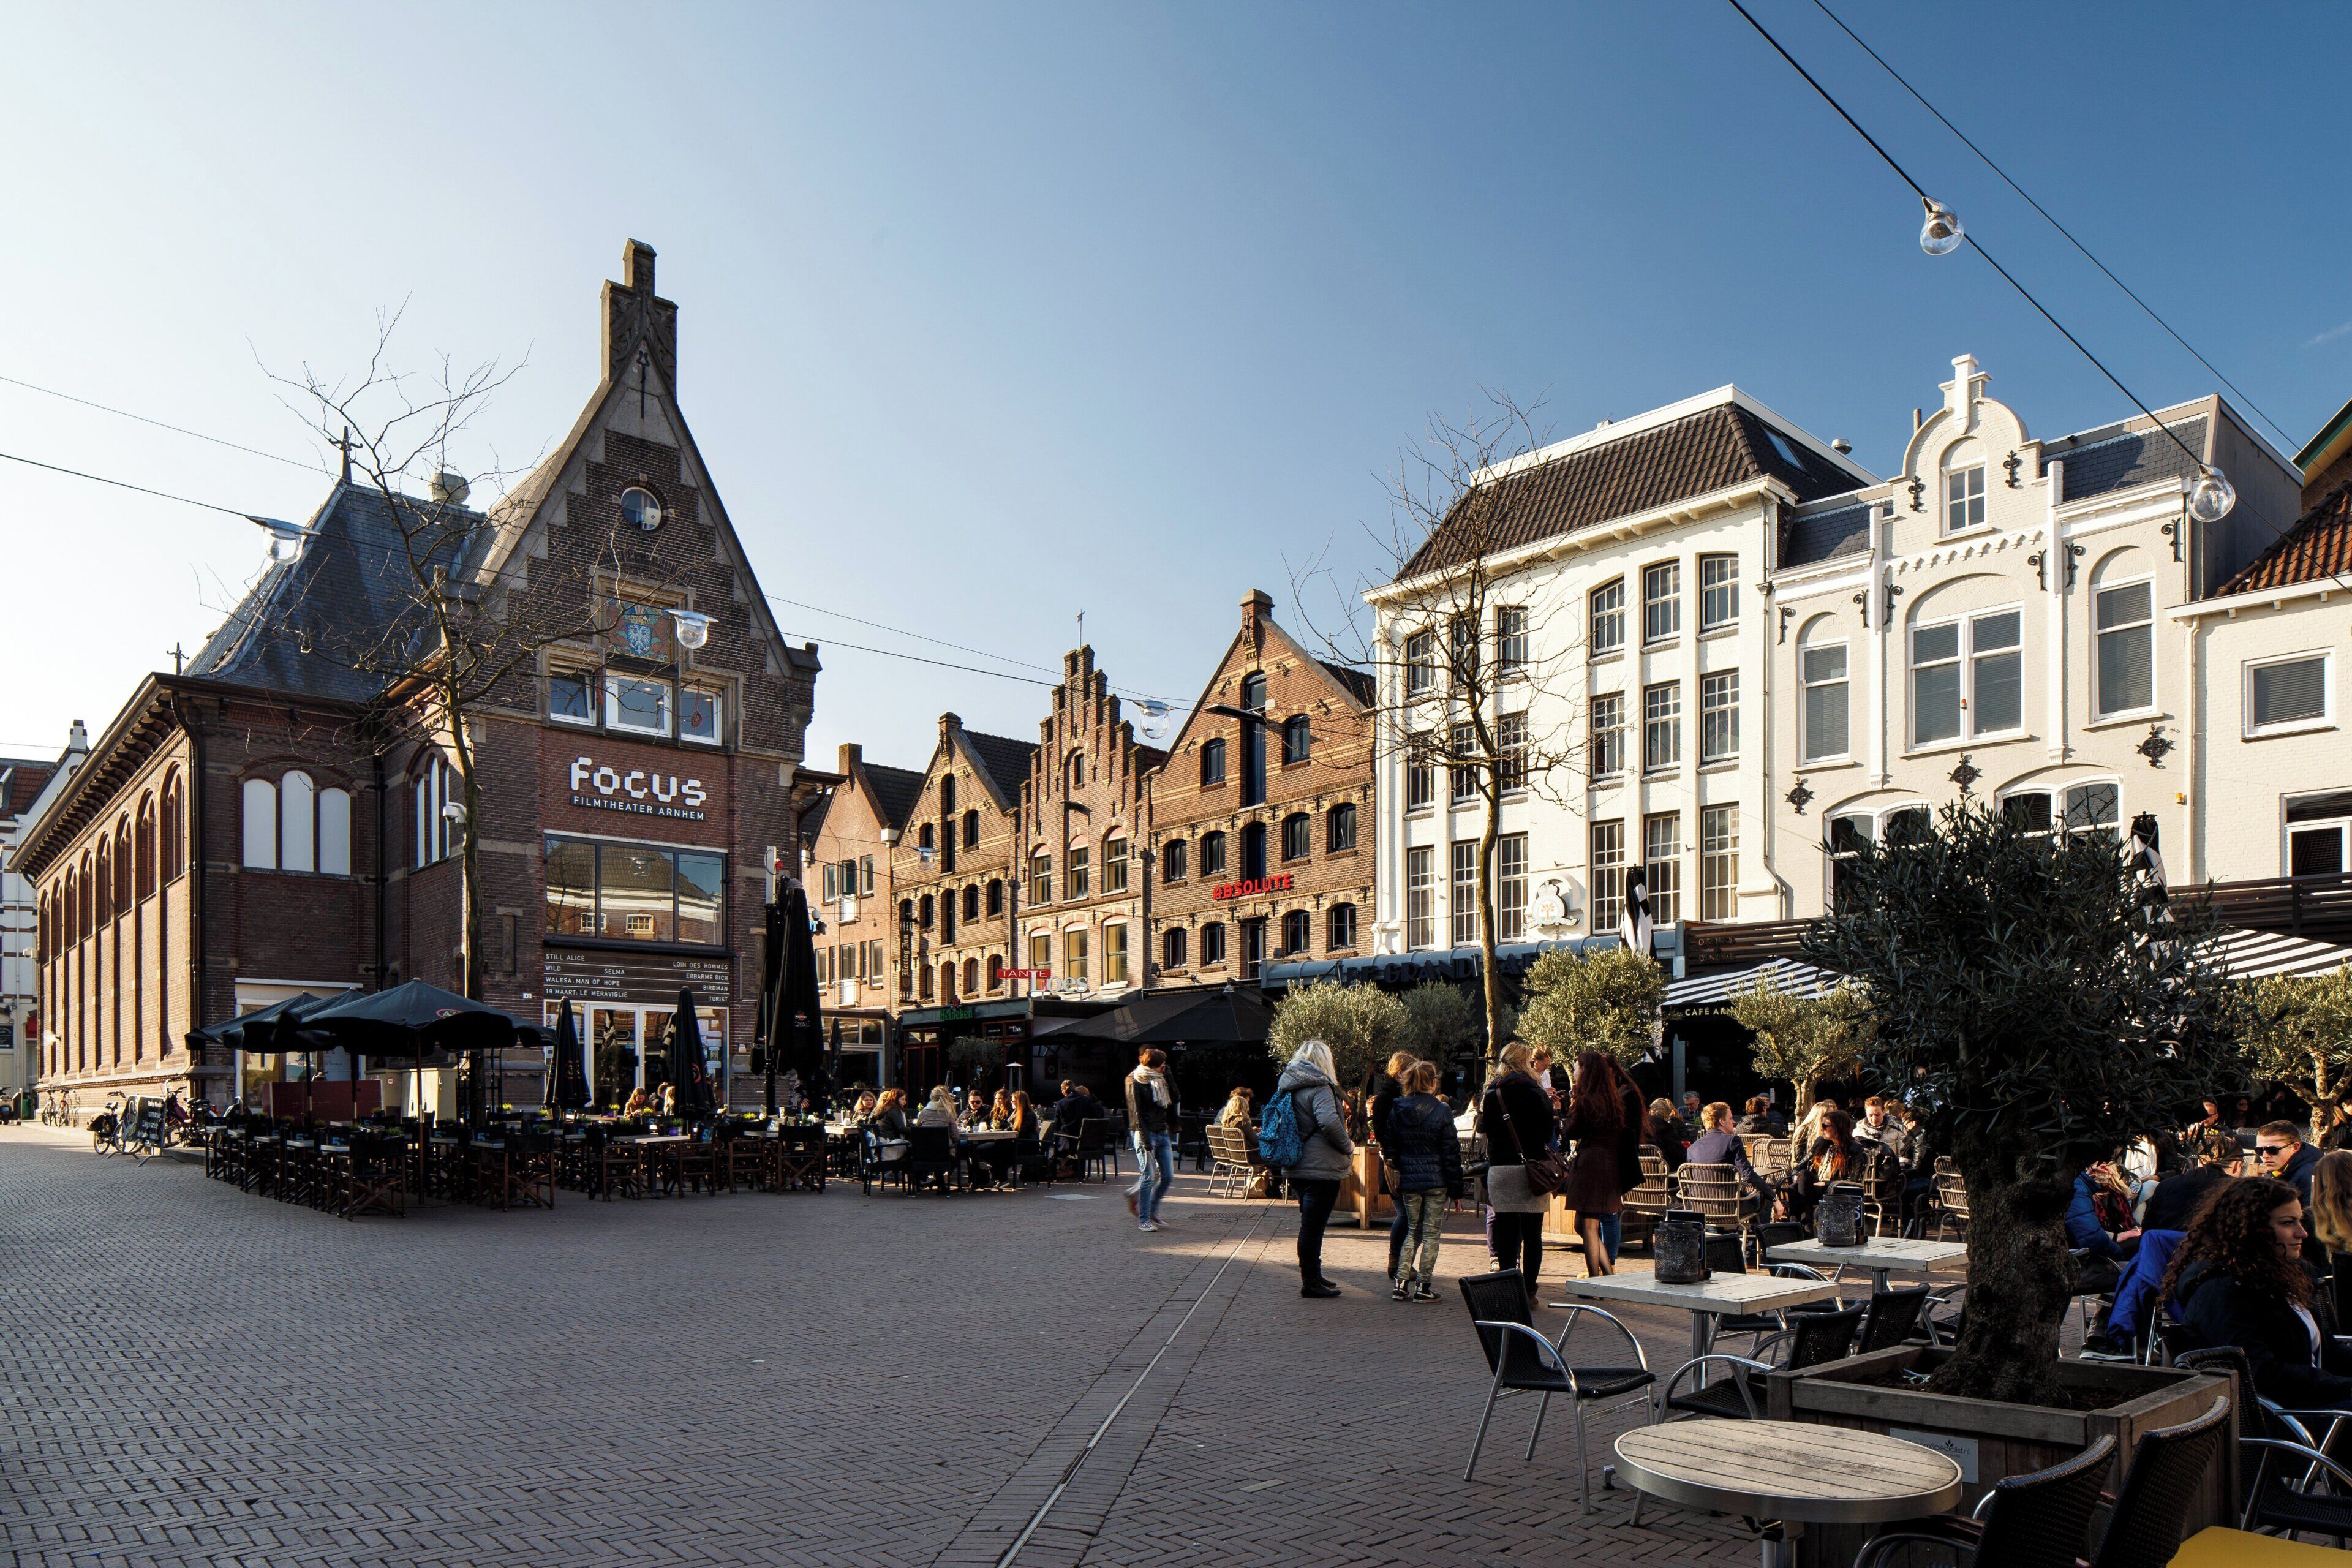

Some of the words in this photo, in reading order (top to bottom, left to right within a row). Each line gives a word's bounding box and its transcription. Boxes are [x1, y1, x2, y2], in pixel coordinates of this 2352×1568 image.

[571, 756, 706, 807] FOCUS
[573, 796, 653, 814] FILMTHEATER
[658, 807, 704, 820] ARNHEM
[1213, 873, 1292, 900] ABSOLUTE
[902, 934, 911, 949] Jan
[902, 951, 911, 977] Hertog
[1384, 958, 1472, 984] GRAND
[1029, 970, 1088, 993] Loes
[940, 1008, 973, 1022] Heineken
[1684, 1006, 1710, 1016] CAFÉ
[1918, 1442, 1970, 1455] omSpecialist.nl
